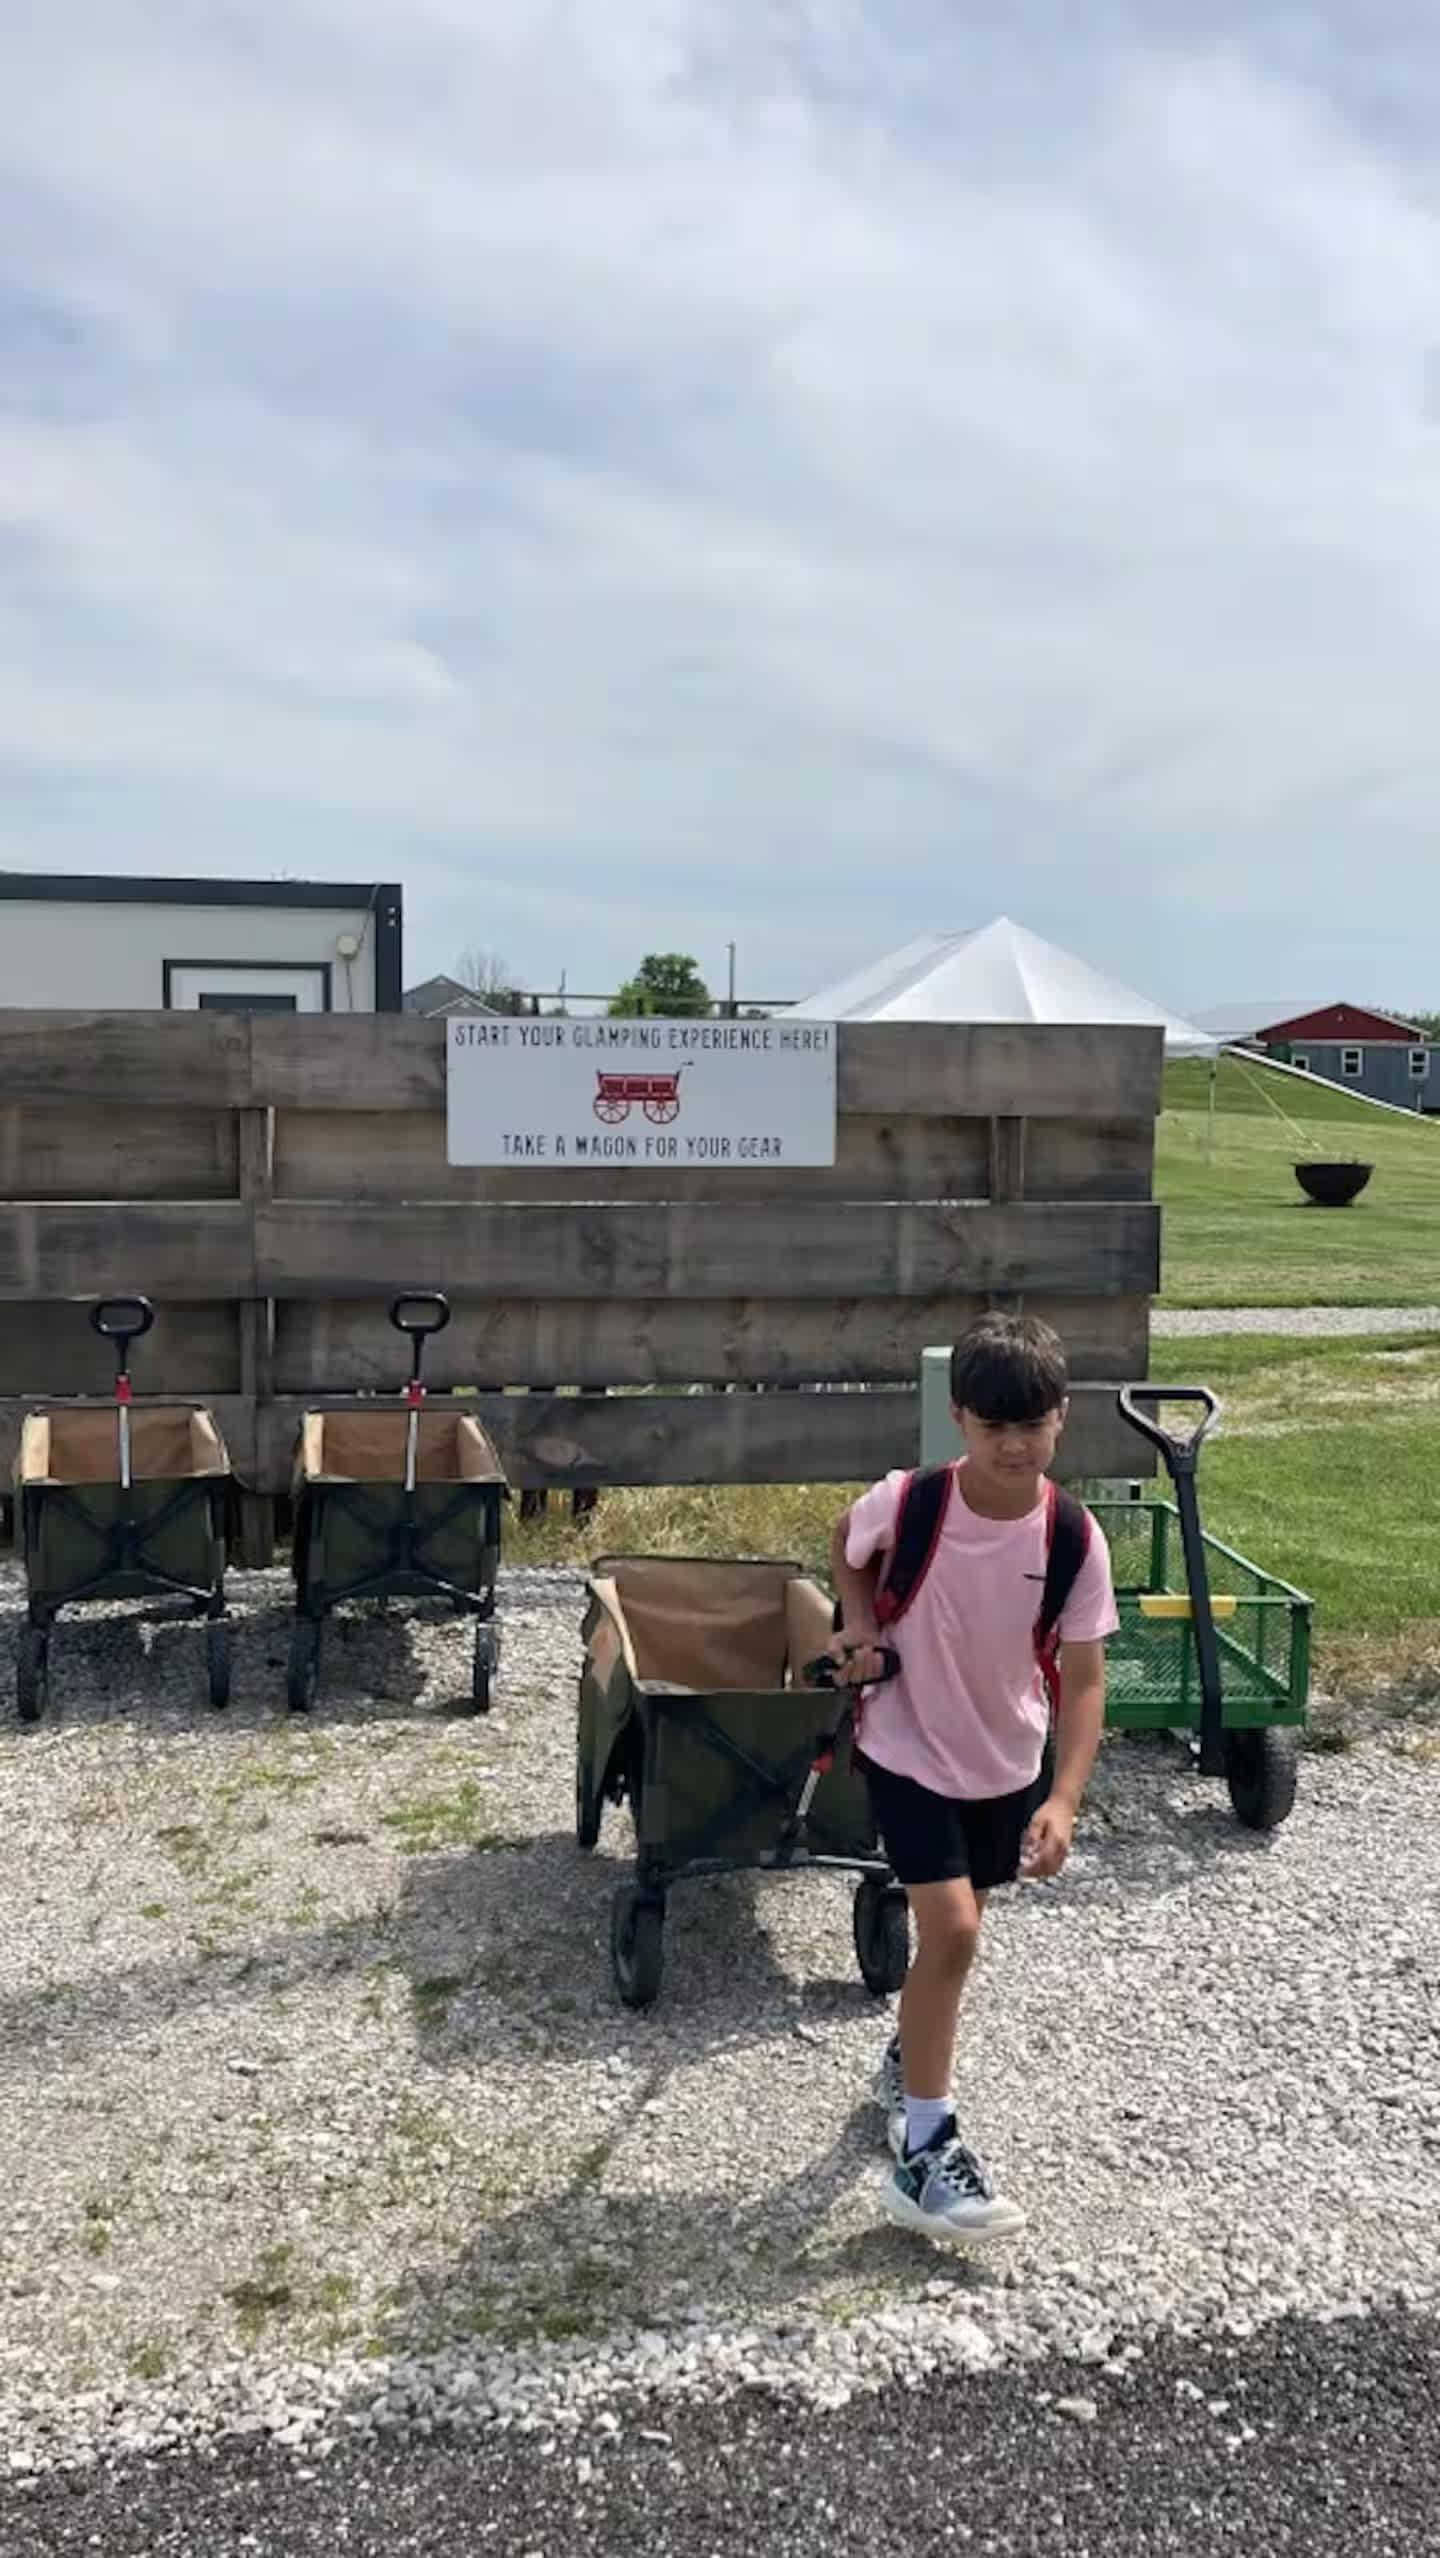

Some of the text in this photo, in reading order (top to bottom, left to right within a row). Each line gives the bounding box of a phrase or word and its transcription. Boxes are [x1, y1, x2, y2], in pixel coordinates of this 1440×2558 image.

[455, 1026, 829, 1050] START YOUR GLAMPING EXPERIENCE HERE!
[502, 1134, 783, 1158] TAKE A WAGON FOR YOUR GEAR
